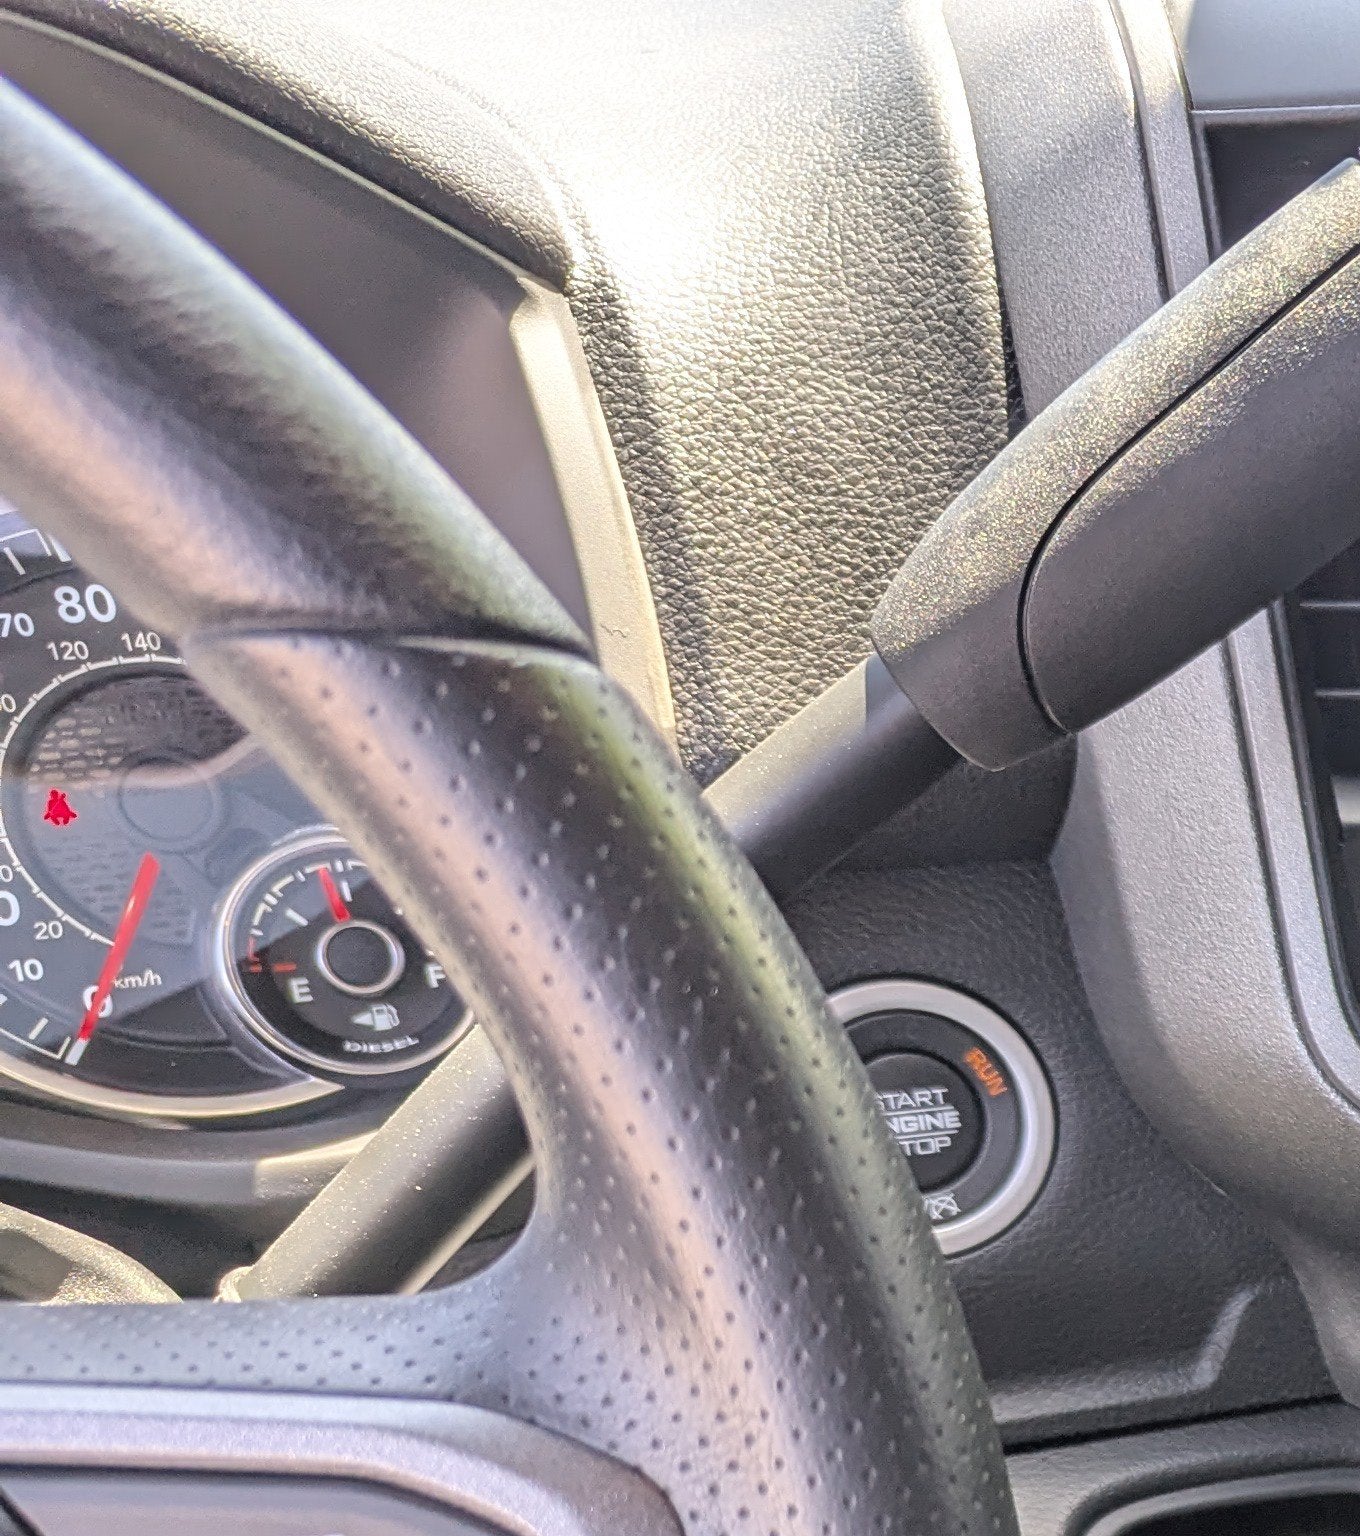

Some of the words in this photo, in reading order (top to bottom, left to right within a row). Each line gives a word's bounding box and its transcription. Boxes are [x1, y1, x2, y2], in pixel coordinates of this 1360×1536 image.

[53, 583, 117, 624] 80
[0, 612, 35, 638] 70
[47, 640, 90, 661] 120
[120, 631, 161, 652] 140
[0, 864, 14, 883] 0
[0, 890, 20, 927] 0
[33, 920, 63, 940] 20
[7, 958, 44, 982] 10
[425, 962, 447, 989] F
[82, 985, 113, 1018] 0
[289, 976, 313, 1004] E
[342, 1034, 420, 1054] DIESEL
[963, 1047, 1008, 1096] RUN
[885, 1110, 962, 1133] NGINE
[898, 1135, 952, 1156] TOP
